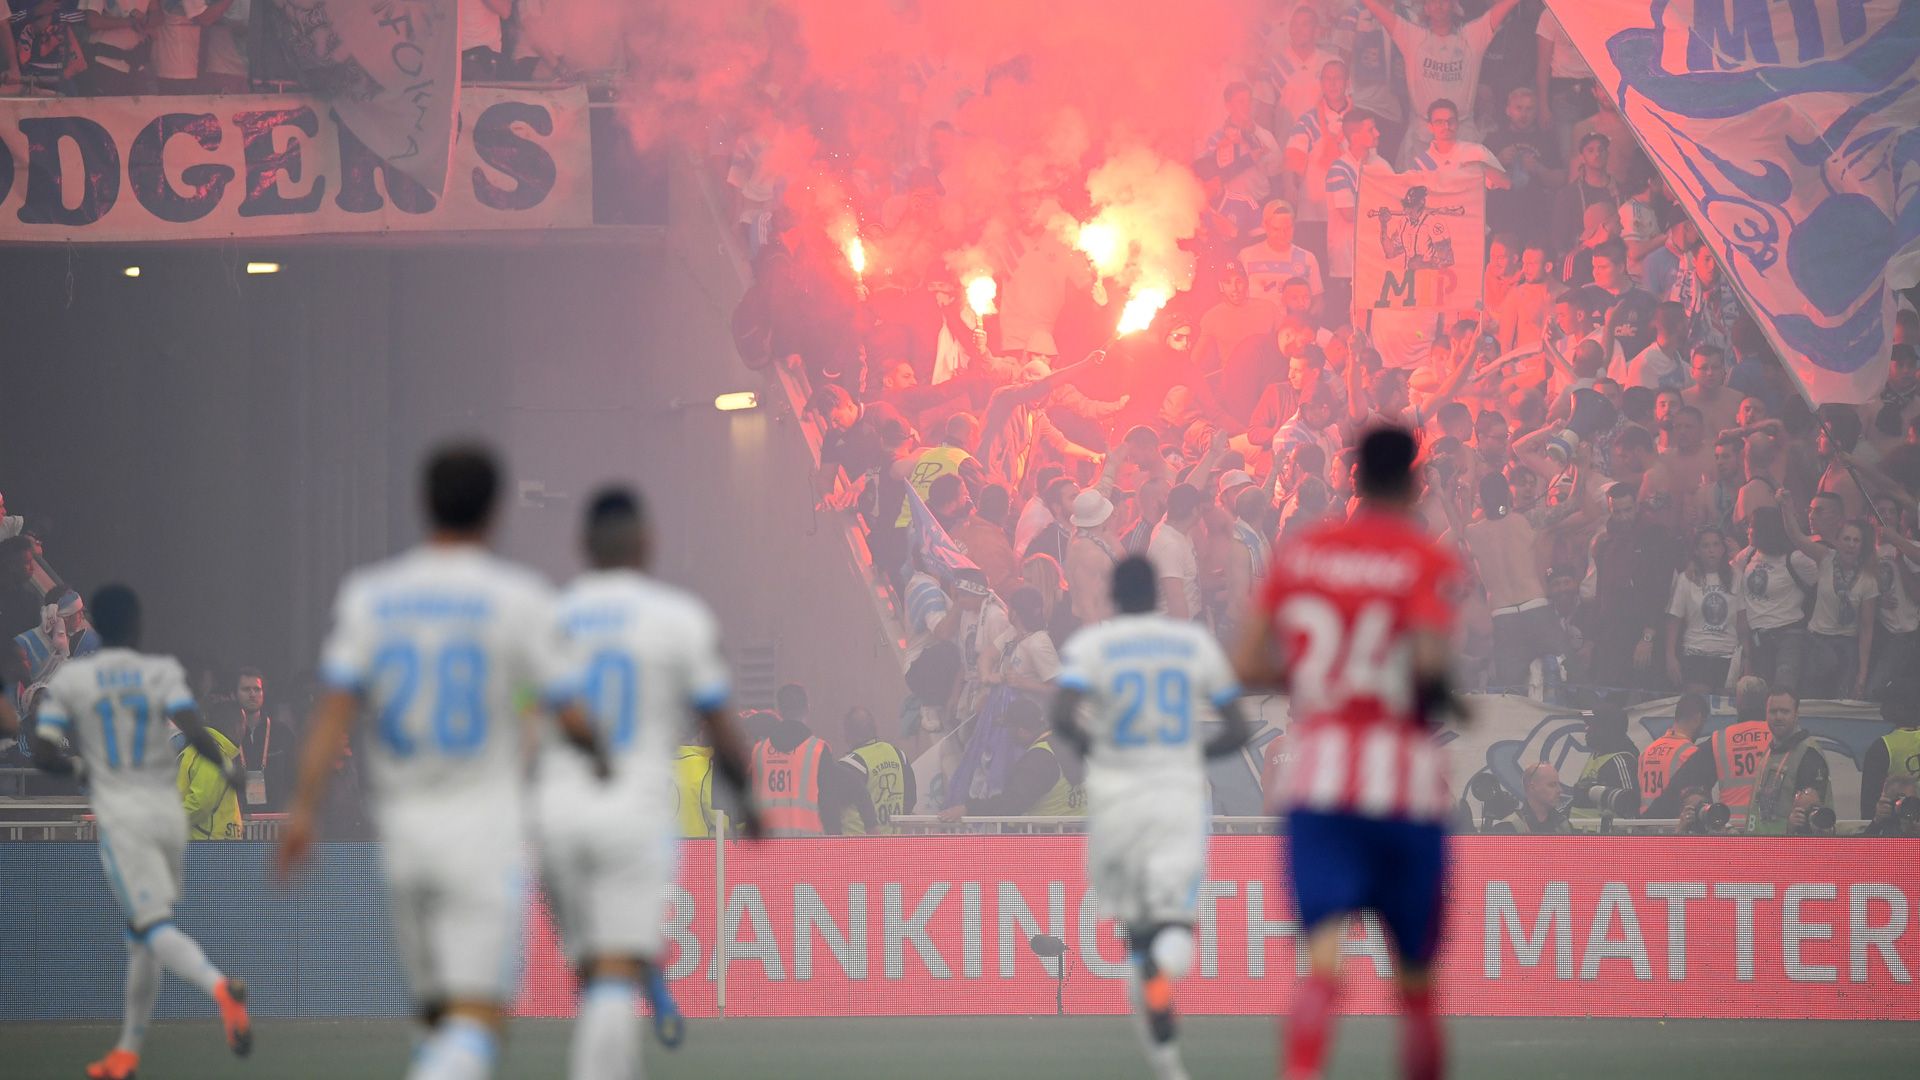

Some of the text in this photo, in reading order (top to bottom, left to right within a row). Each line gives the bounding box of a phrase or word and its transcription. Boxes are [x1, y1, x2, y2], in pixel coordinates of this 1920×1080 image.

[0, 101, 557, 226] DGES
[1276, 591, 1414, 712] 24
[96, 694, 148, 770] 17
[371, 639, 489, 757] 28
[1113, 667, 1191, 747] 29
[1732, 731, 1770, 744] ONET
[768, 769, 792, 792] 681
[1643, 771, 1664, 794] 134
[1196, 880, 1396, 979] THA
[1483, 880, 1912, 983] MATTER
